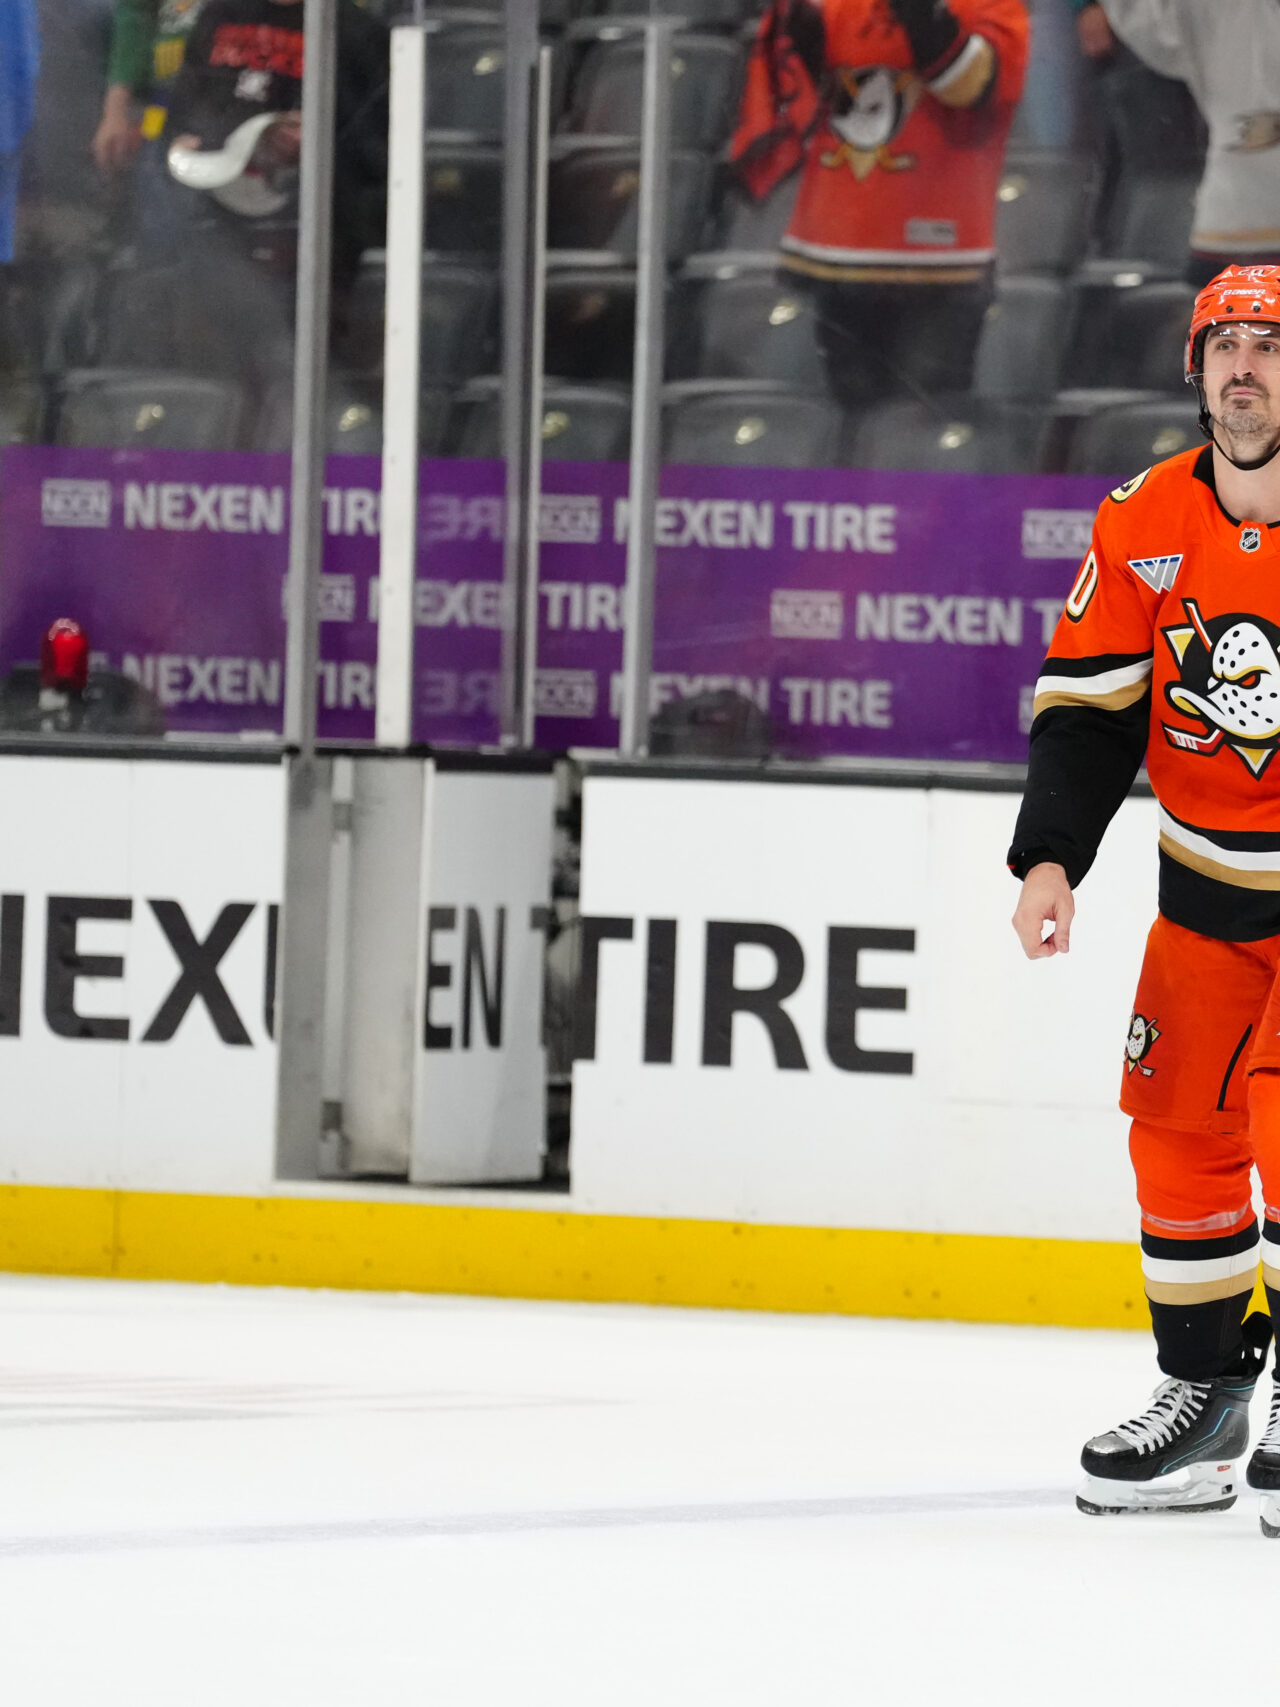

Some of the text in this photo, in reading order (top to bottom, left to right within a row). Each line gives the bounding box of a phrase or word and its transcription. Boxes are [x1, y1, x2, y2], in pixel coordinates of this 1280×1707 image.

[123, 481, 284, 534] NEXEN
[321, 487, 381, 535] IR
[783, 502, 898, 553] TIRE
[538, 579, 628, 631] TIR
[855, 592, 1023, 645] NEXEN
[121, 653, 378, 710] NEXEN IR
[780, 678, 893, 728] TIRE
